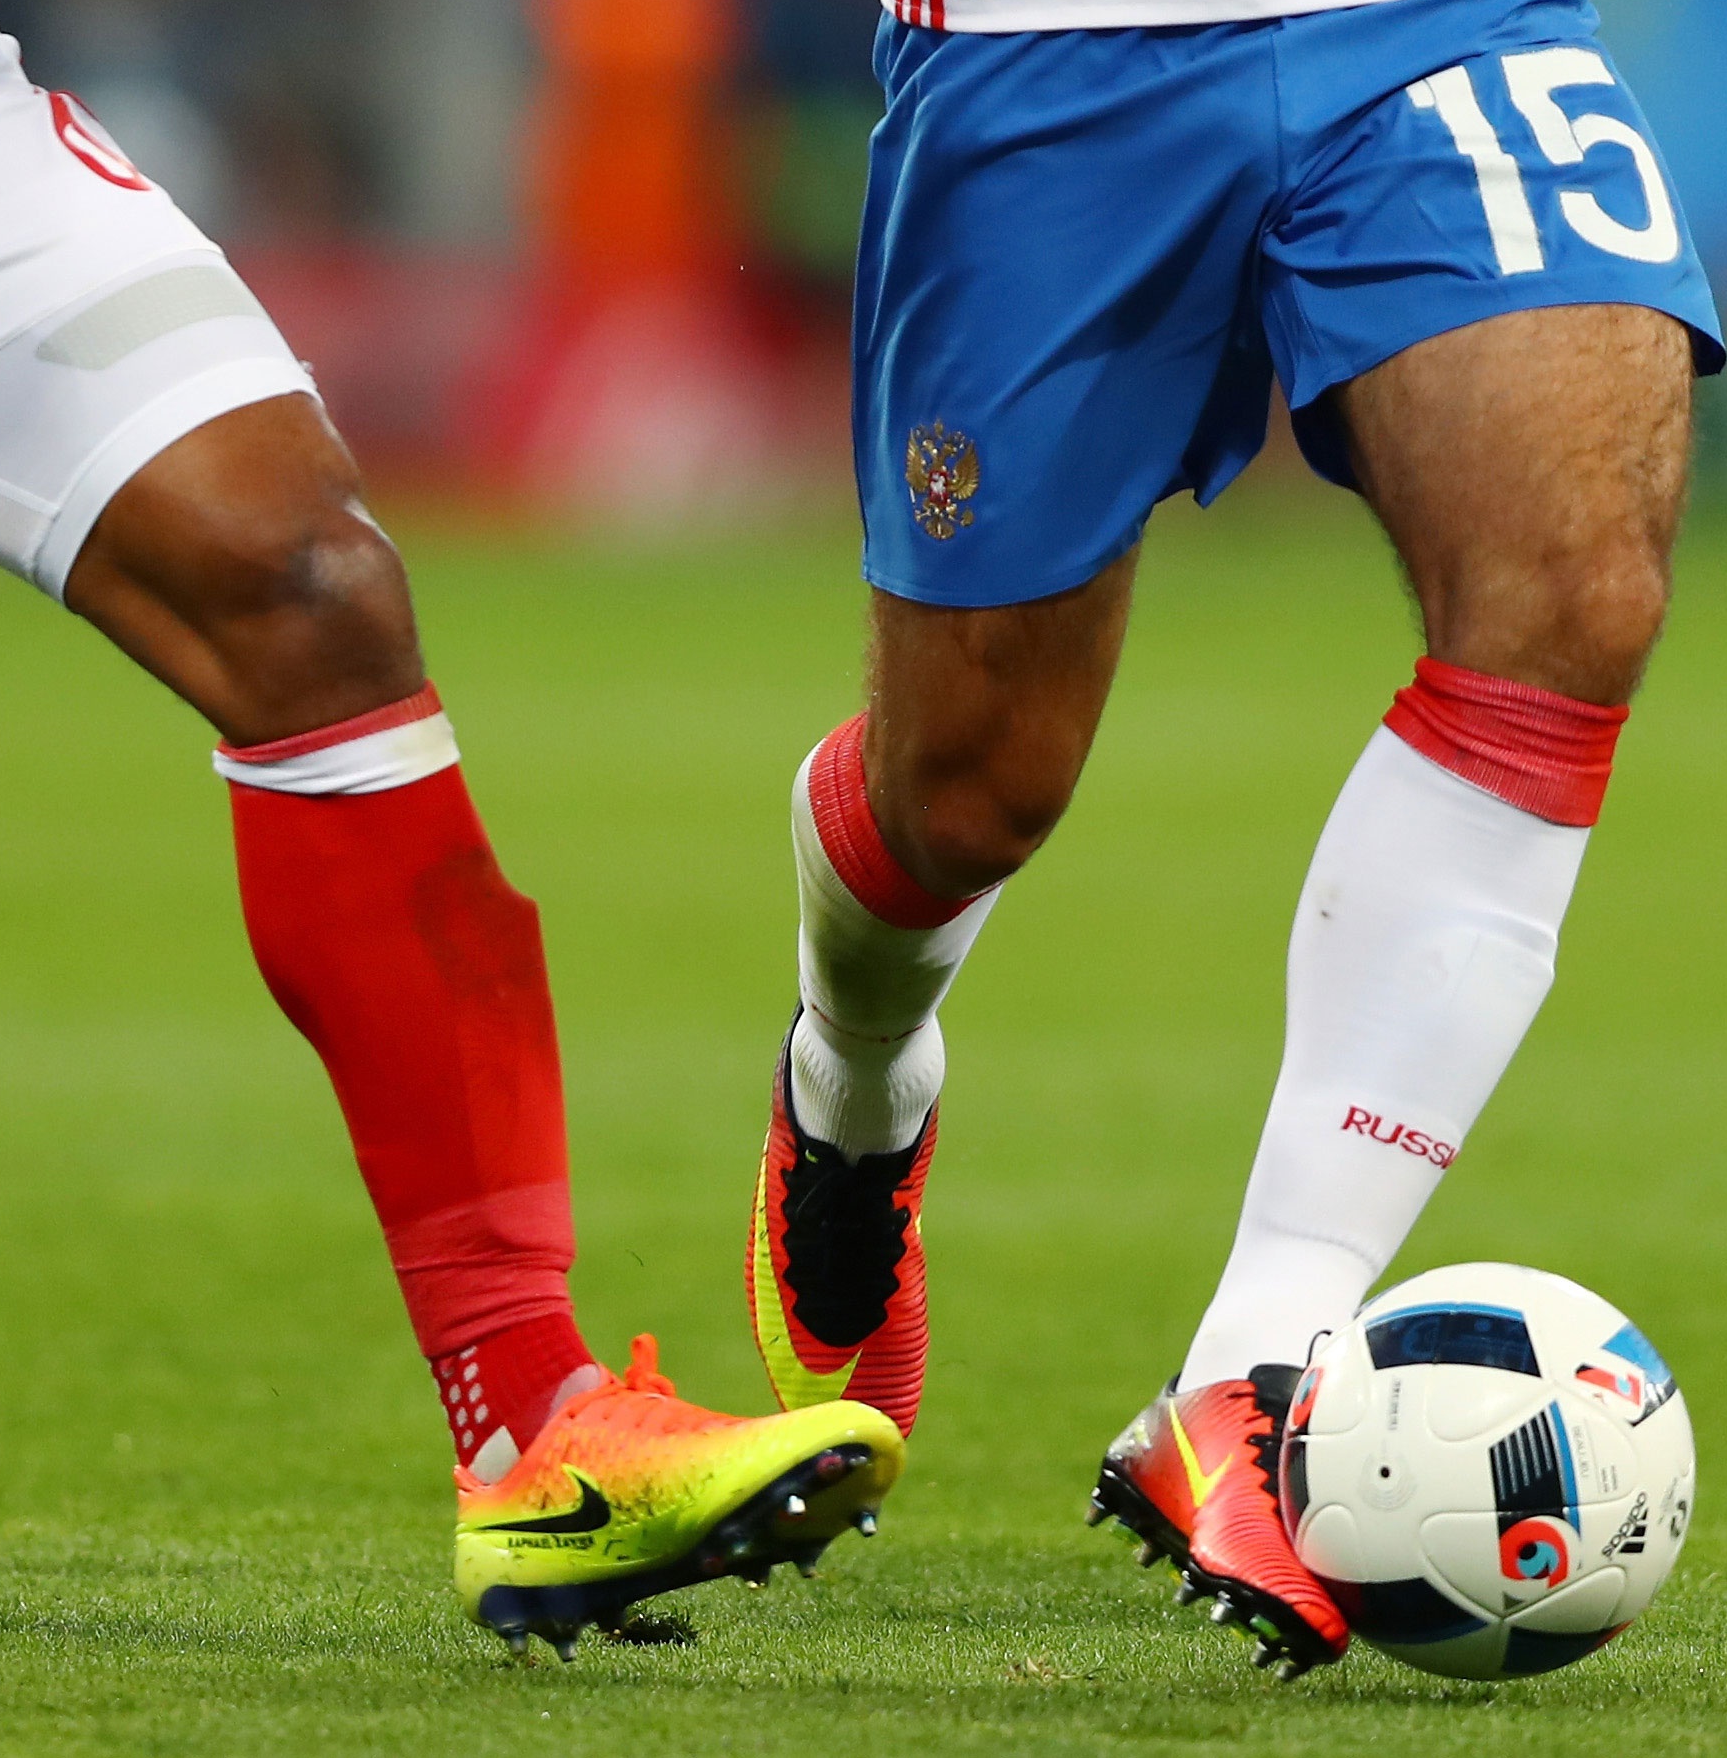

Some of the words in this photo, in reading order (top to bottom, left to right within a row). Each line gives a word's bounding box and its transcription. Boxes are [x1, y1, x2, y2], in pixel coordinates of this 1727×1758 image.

[1404, 46, 1680, 276] 15
[1341, 1105, 1459, 1170] RUSSI
[1600, 1490, 1647, 1557] adidas
